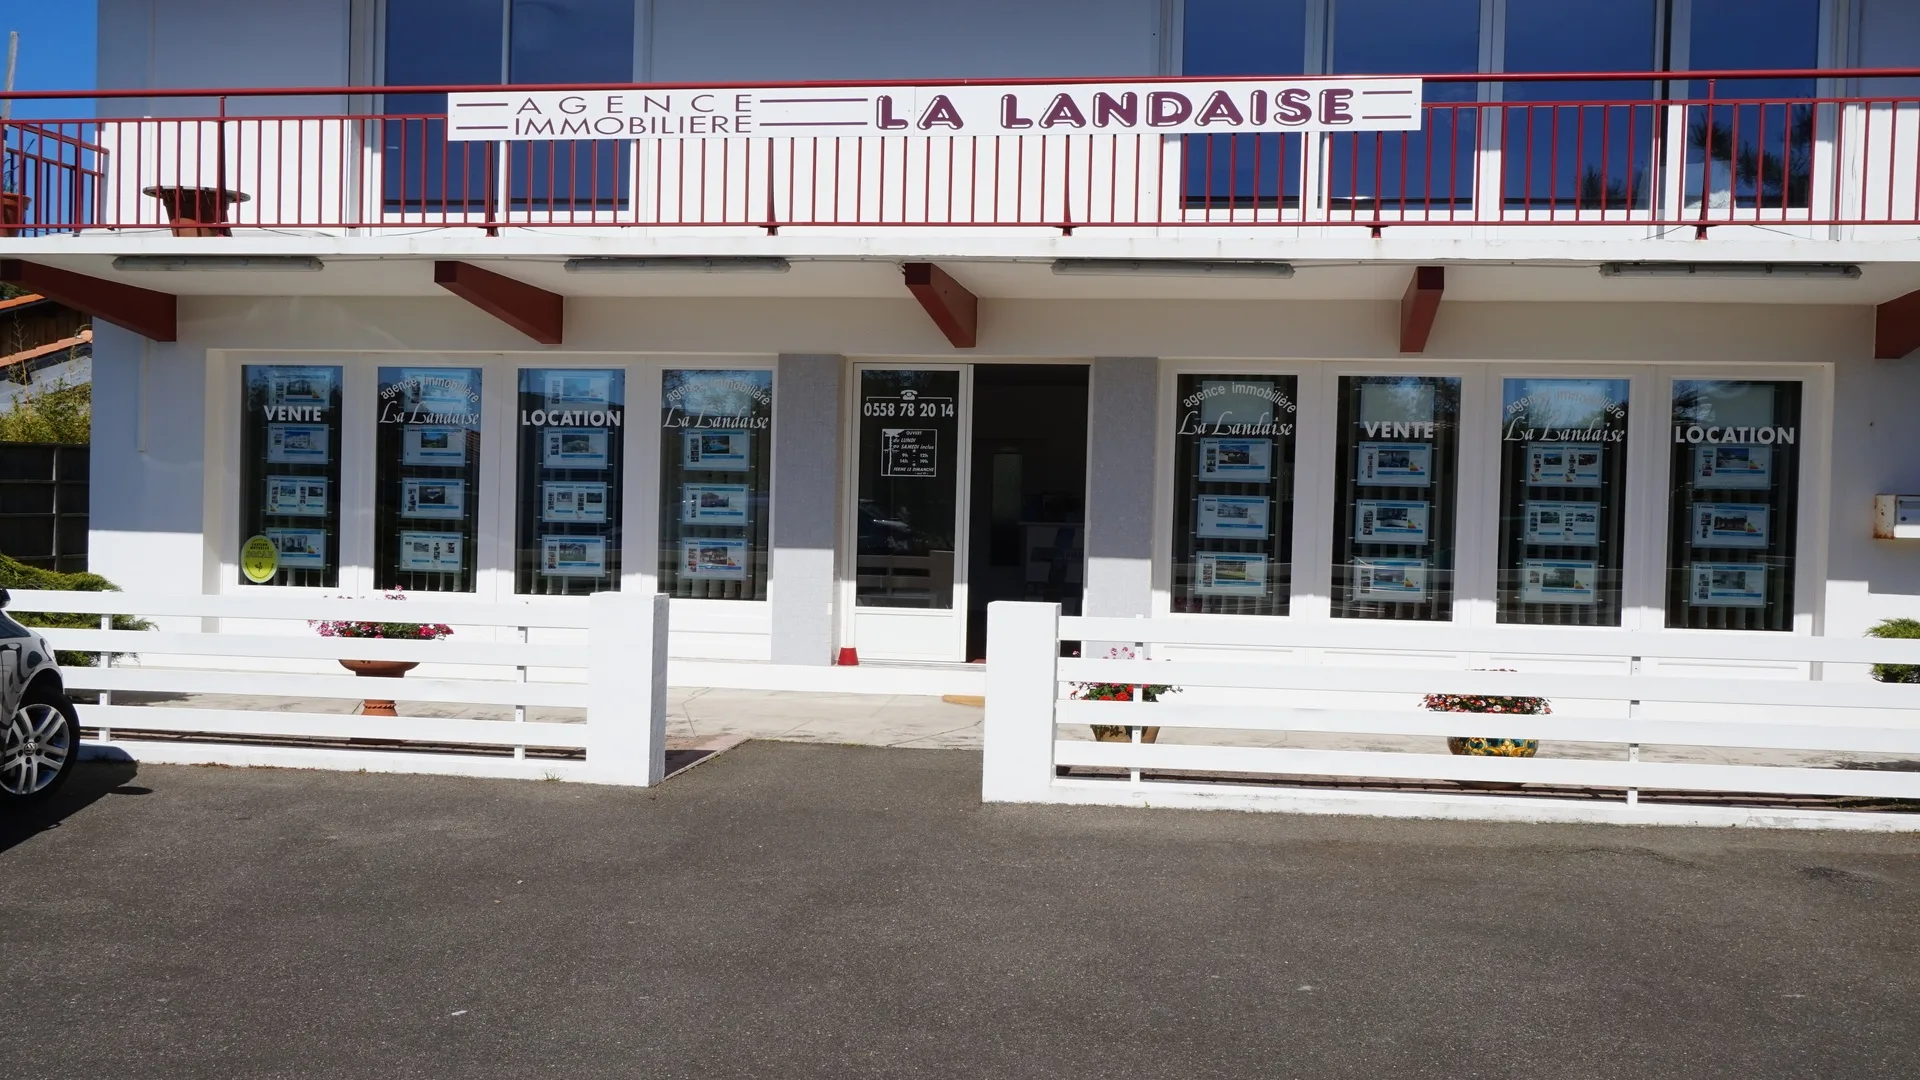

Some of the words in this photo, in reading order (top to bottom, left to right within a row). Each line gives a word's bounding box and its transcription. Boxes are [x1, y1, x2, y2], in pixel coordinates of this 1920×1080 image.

[516, 94, 752, 114] AGENCE
[876, 94, 964, 131] LA
[1000, 88, 1353, 129] LANDAISE
[515, 116, 752, 135] IMMOBILIERE
[381, 378, 418, 400] agence
[1183, 385, 1225, 408] agence
[1231, 382, 1297, 413] immobilière
[263, 405, 322, 422] VENTE
[379, 401, 405, 424] La
[409, 401, 480, 425] Landaise
[522, 409, 621, 427] LOCATION
[663, 405, 690, 427] La
[694, 405, 769, 429] Landaise
[864, 402, 895, 417] 0558
[900, 403, 915, 417] 78
[920, 403, 936, 417] 20
[941, 403, 954, 417] 14
[1177, 410, 1207, 435] La
[1211, 410, 1293, 436] Landaise
[1364, 421, 1434, 439] VENTE
[1503, 416, 1535, 441] La
[1539, 417, 1625, 443] Landaise
[1675, 426, 1795, 445] LOCATION
